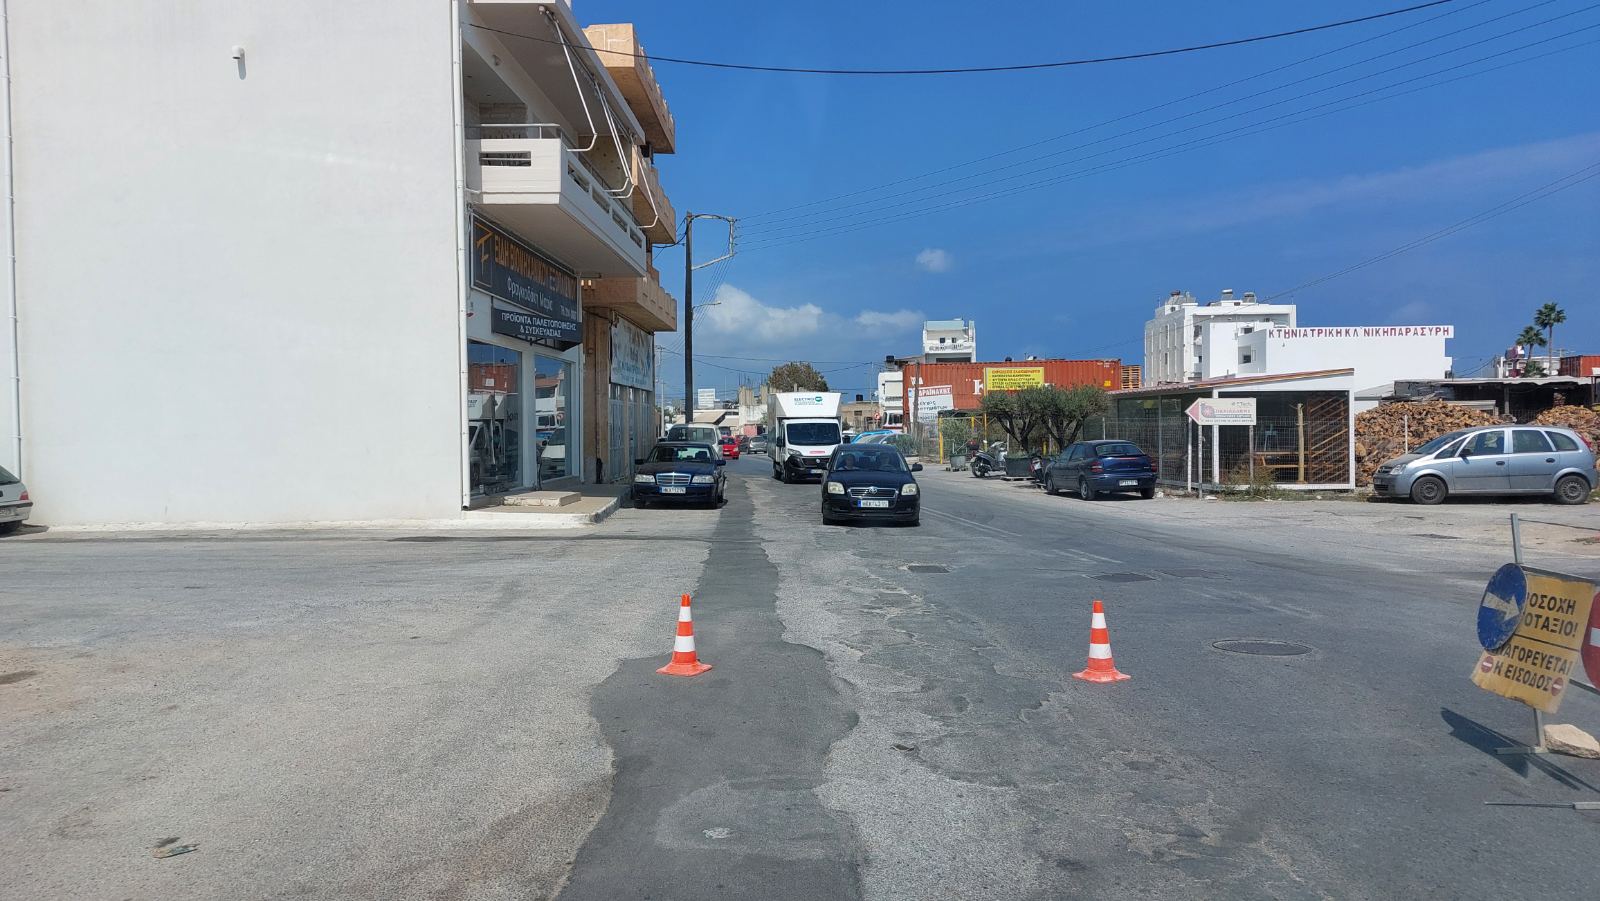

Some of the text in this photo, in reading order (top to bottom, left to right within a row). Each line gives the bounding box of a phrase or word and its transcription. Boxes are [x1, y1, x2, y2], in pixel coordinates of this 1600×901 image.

[519, 325, 525, 333] &
[1268, 328, 1343, 339] ΚΤΗΝΙΑΤΡΙΚΗ
[1526, 592, 1577, 616] ΟΣΟΧΗ
[1522, 611, 1579, 638] ΟΤΑΞΙΟ!
[1498, 644, 1574, 676] ΑΓΟΡΕΥΕΤΑΙ
[1493, 661, 1553, 692] Η ΕΙΣΟΔΟΣ
